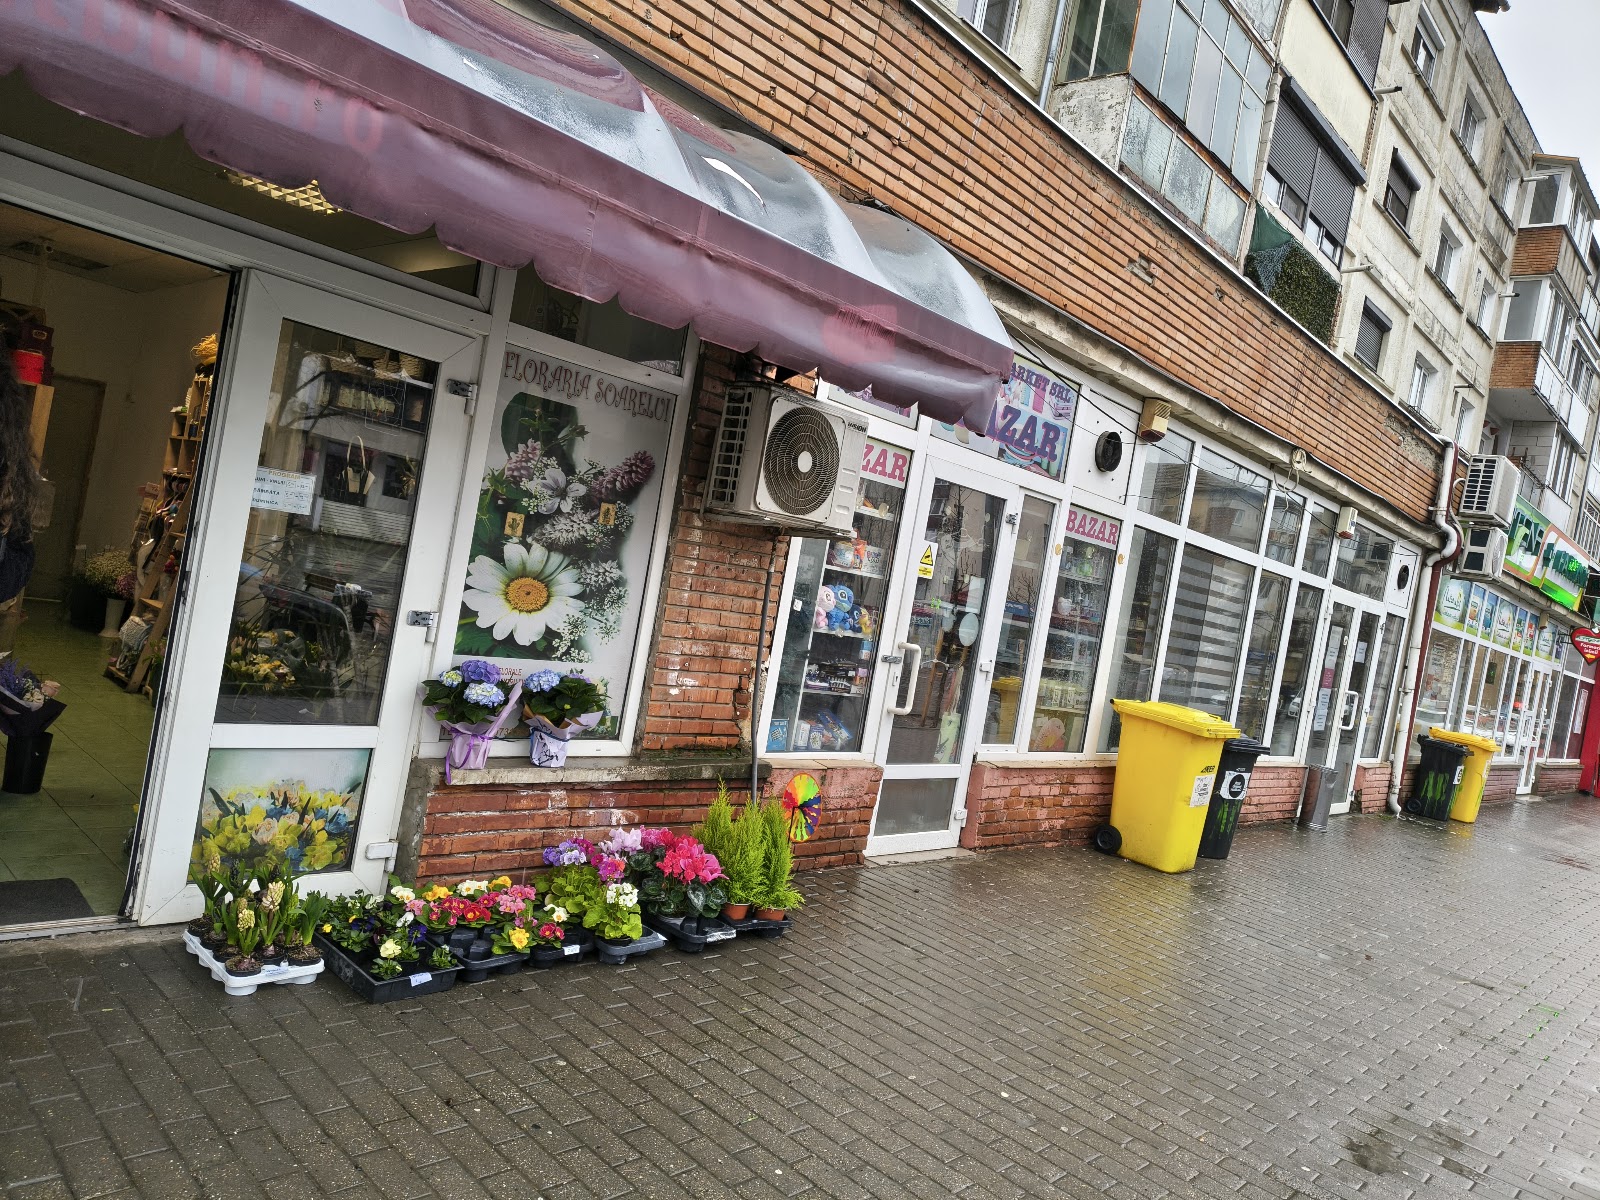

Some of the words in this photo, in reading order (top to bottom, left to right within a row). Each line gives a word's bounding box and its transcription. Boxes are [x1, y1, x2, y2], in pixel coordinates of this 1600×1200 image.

[504, 351, 592, 400] FLORARIA
[594, 377, 671, 423] SOARELUI
[1009, 362, 1051, 393] ARKET
[1049, 381, 1073, 403] SRL
[268, 469, 302, 480] PROGRAM
[861, 443, 908, 483] ZAR
[1066, 509, 1119, 546] BAZAR
